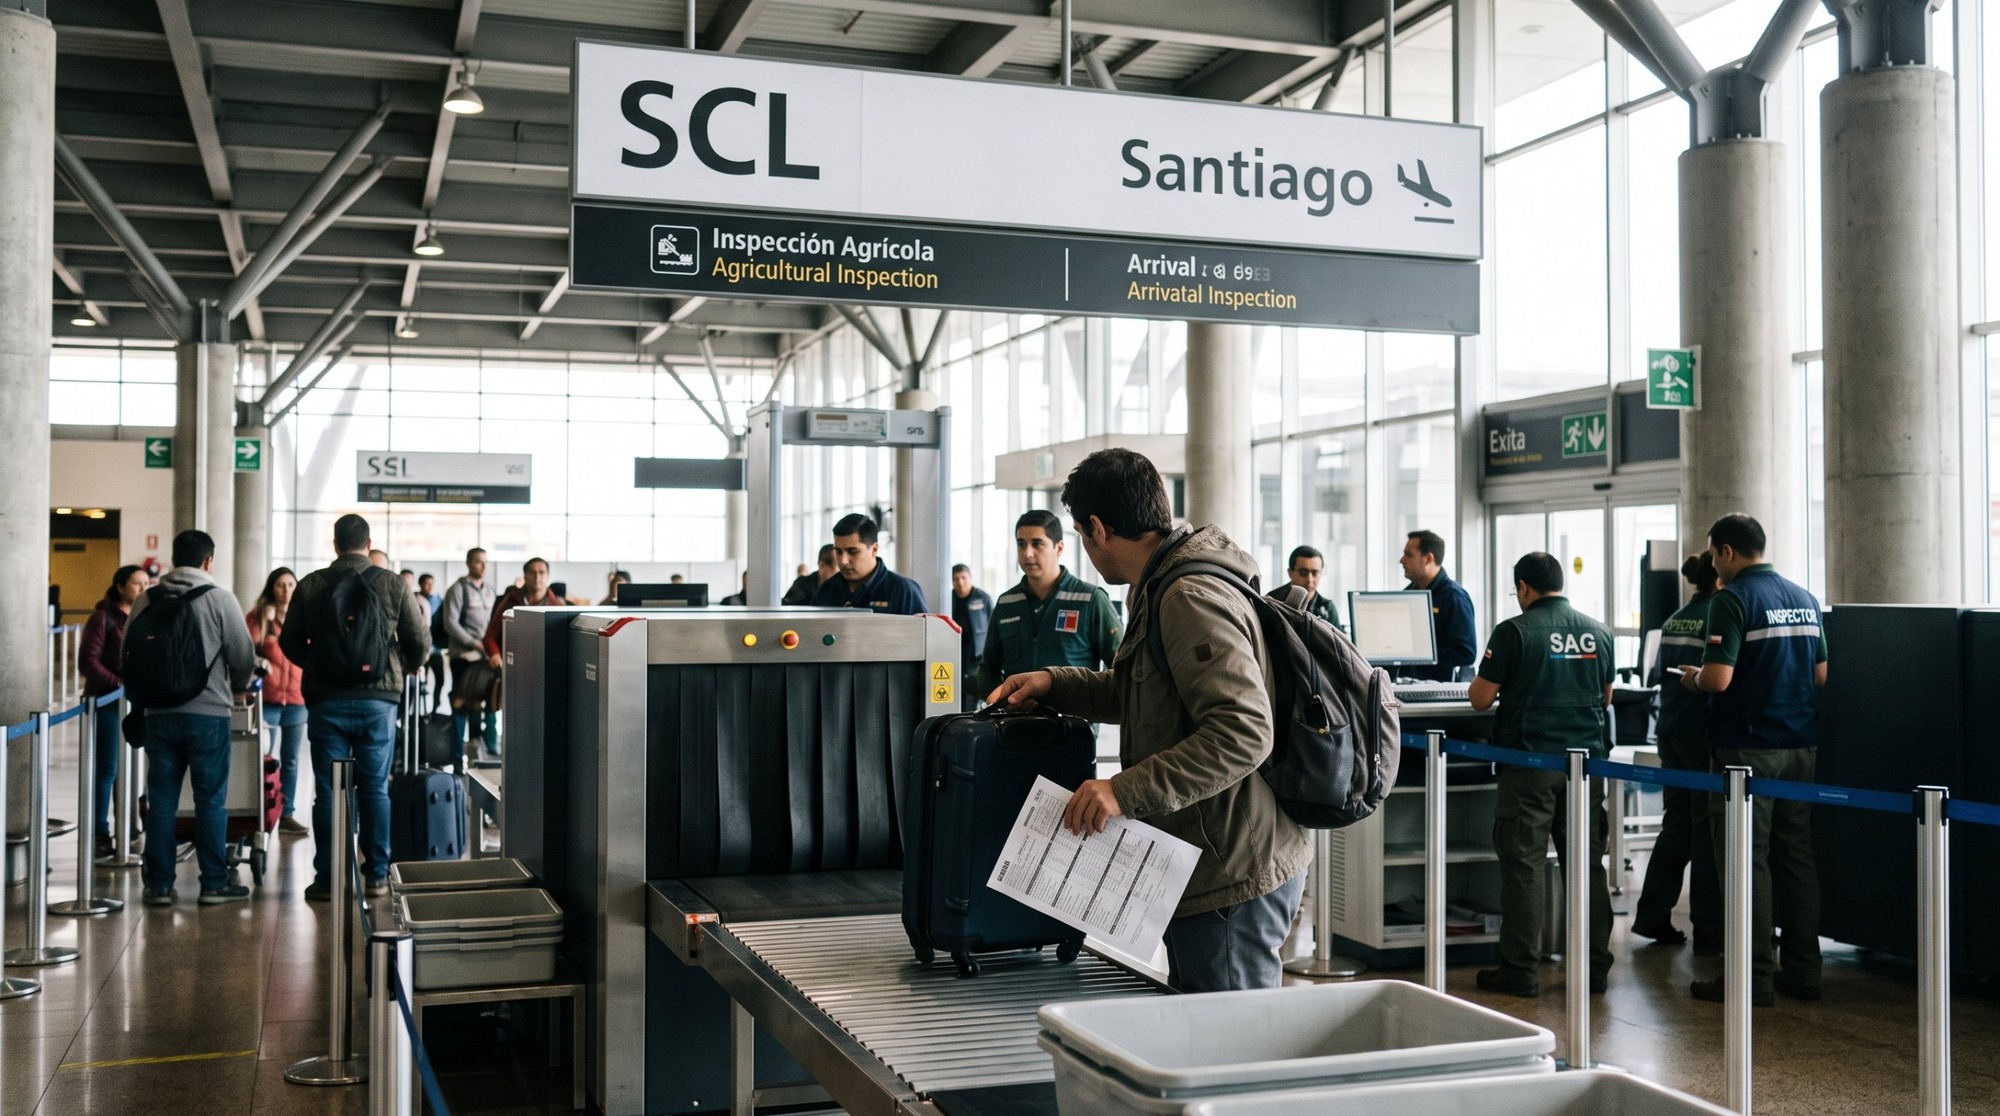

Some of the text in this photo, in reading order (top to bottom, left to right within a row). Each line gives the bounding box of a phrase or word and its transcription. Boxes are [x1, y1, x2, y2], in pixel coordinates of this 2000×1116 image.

[620, 79, 820, 180] SCL
[1121, 138, 1373, 217] Santiago
[713, 227, 934, 263] Inspección Agrícola
[712, 257, 938, 291] Agricultural Inspection
[1127, 253, 1196, 277] Arrival
[1127, 281, 1297, 311] Arrivatal Inspection
[1490, 427, 1526, 453] Exita
[1765, 608, 1818, 625] INSPECTOR
[1550, 632, 1597, 653] SAG
